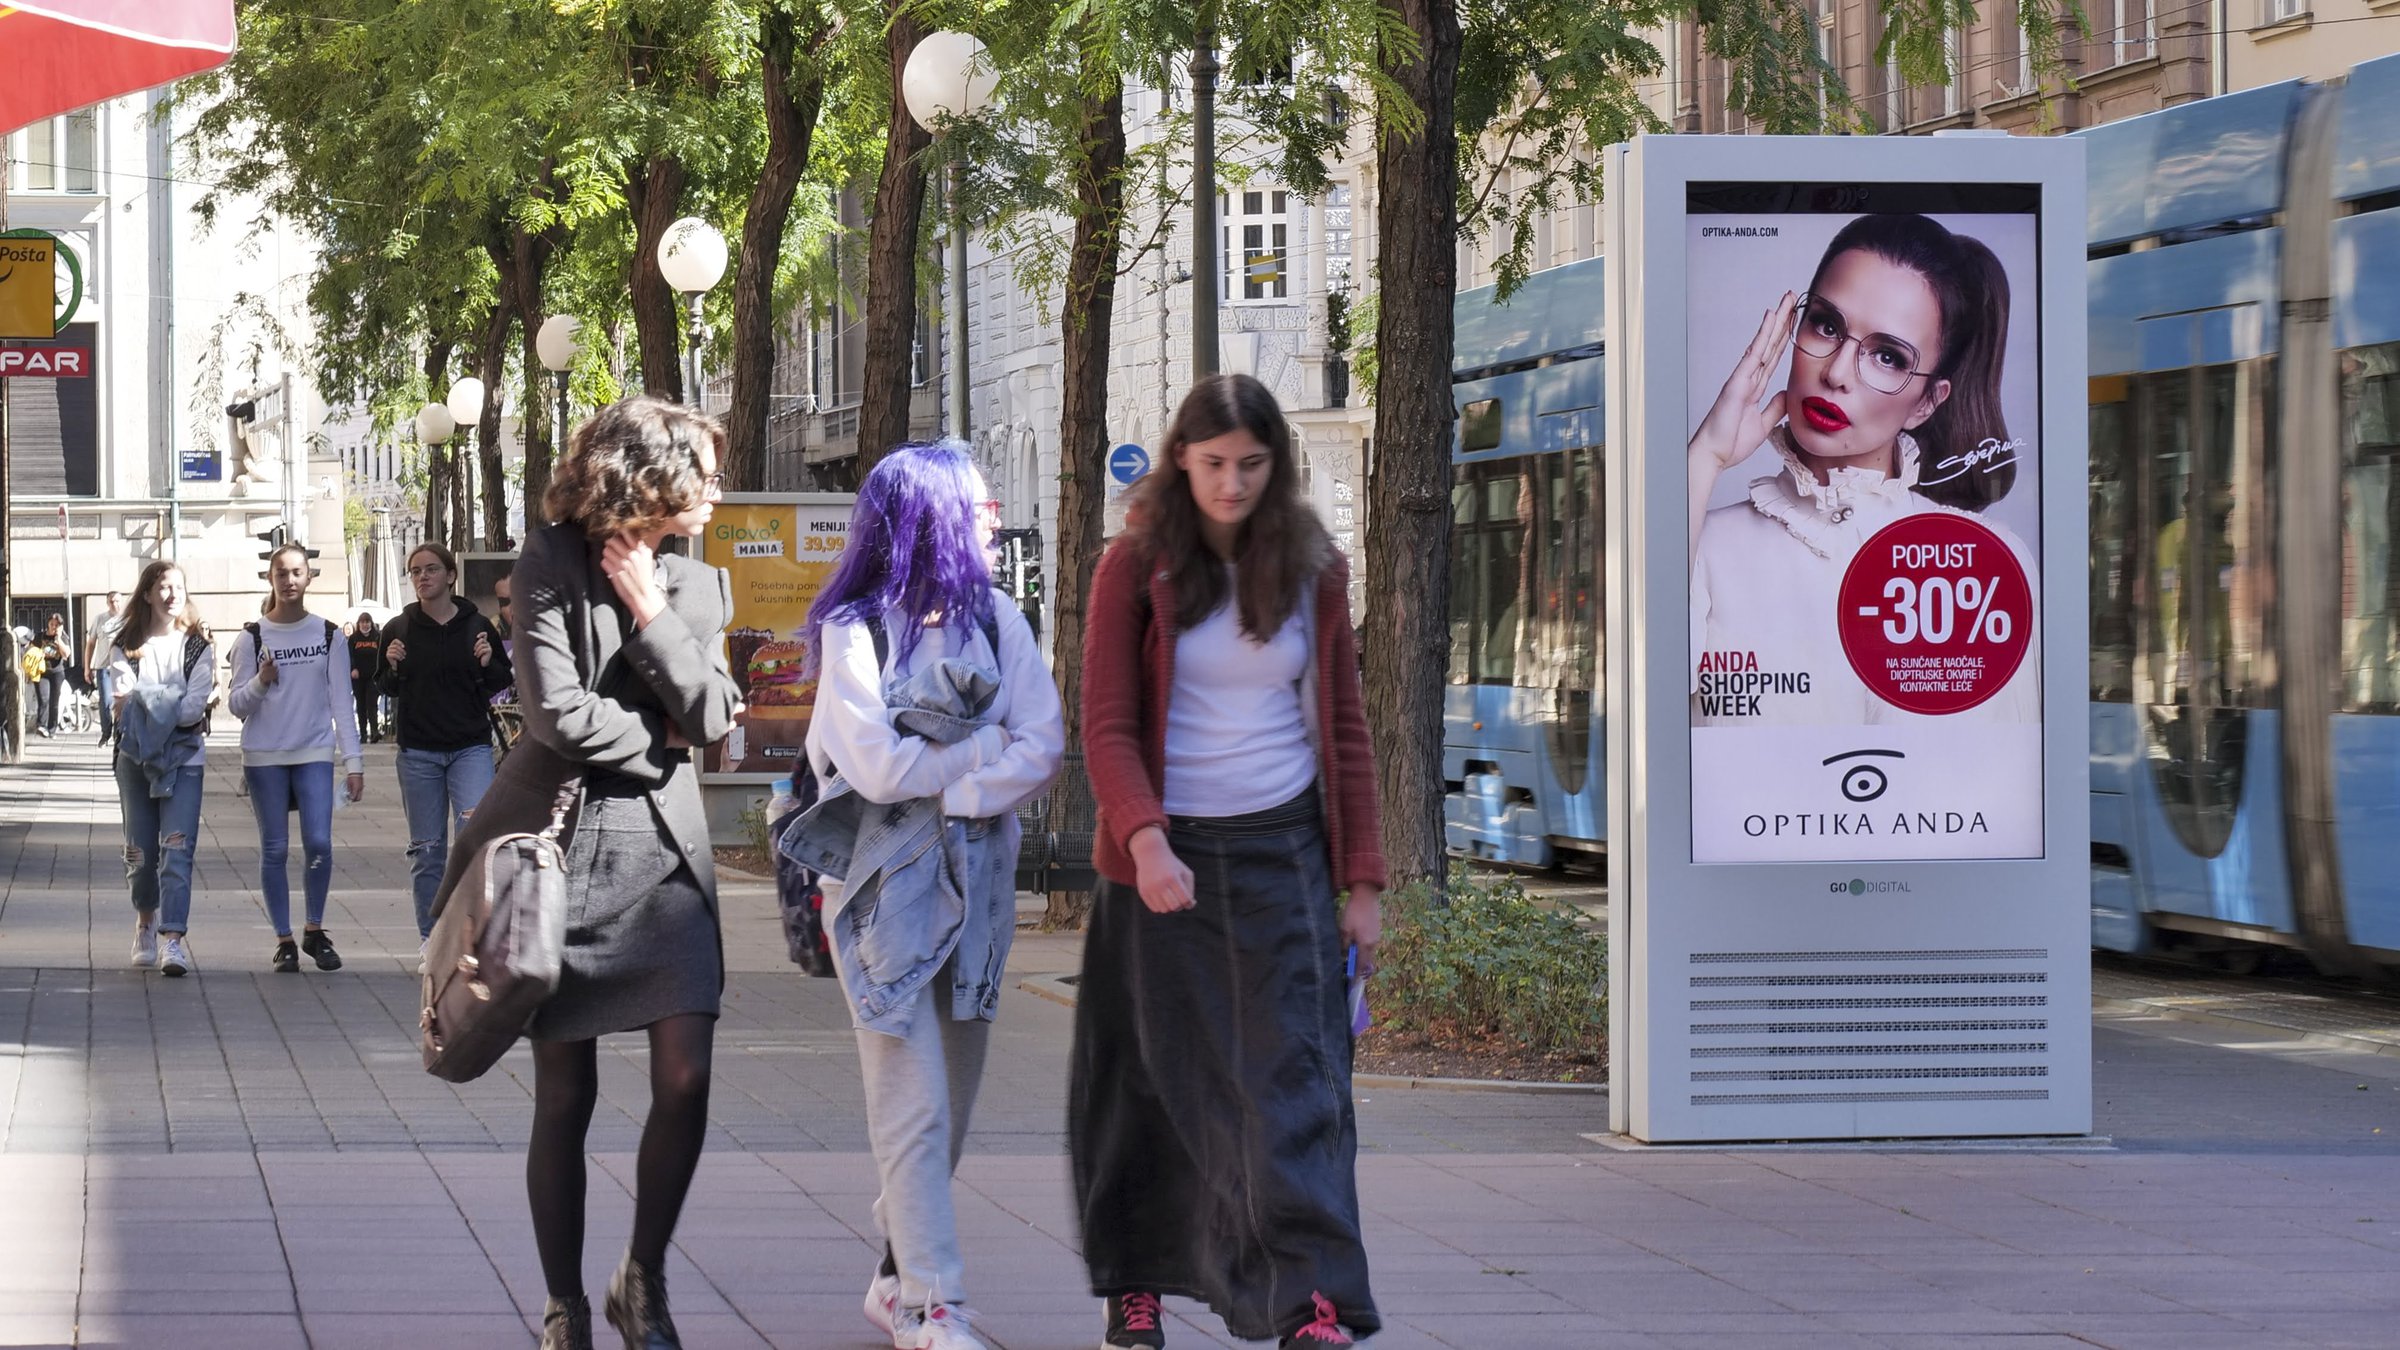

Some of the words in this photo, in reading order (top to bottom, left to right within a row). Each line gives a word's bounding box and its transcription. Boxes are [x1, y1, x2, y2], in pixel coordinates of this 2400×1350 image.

[1702, 227, 1778, 237] OPTIKA-ANDA.COM
[0, 247, 46, 262] Pošta
[715, 525, 771, 540] Glovo
[810, 521, 846, 532] MENIJI
[739, 544, 778, 555] MANIA
[803, 536, 845, 552] 39,99
[1892, 543, 1977, 569] POPUST
[751, 581, 794, 590] Posebna
[754, 595, 793, 604] ukusnih
[1859, 576, 2012, 644] -30%
[1699, 651, 1759, 672] ANDA
[1886, 658, 1899, 668] NA
[1900, 655, 1941, 668] SUNČANE
[1943, 655, 1986, 668] NAOČALE,
[1890, 669, 1944, 680] DIOPTRIJSKE
[1946, 669, 1977, 680] OKVIRE
[1700, 672, 1811, 694] SHOPPING
[1900, 681, 1949, 692] KONTAKTNE
[1700, 695, 1761, 716] WEEK
[1743, 813, 1874, 836] OPTIKA
[1891, 811, 1989, 834] ANDA
[1830, 882, 1847, 893] GO
[1866, 881, 1911, 893] DIGITAL
